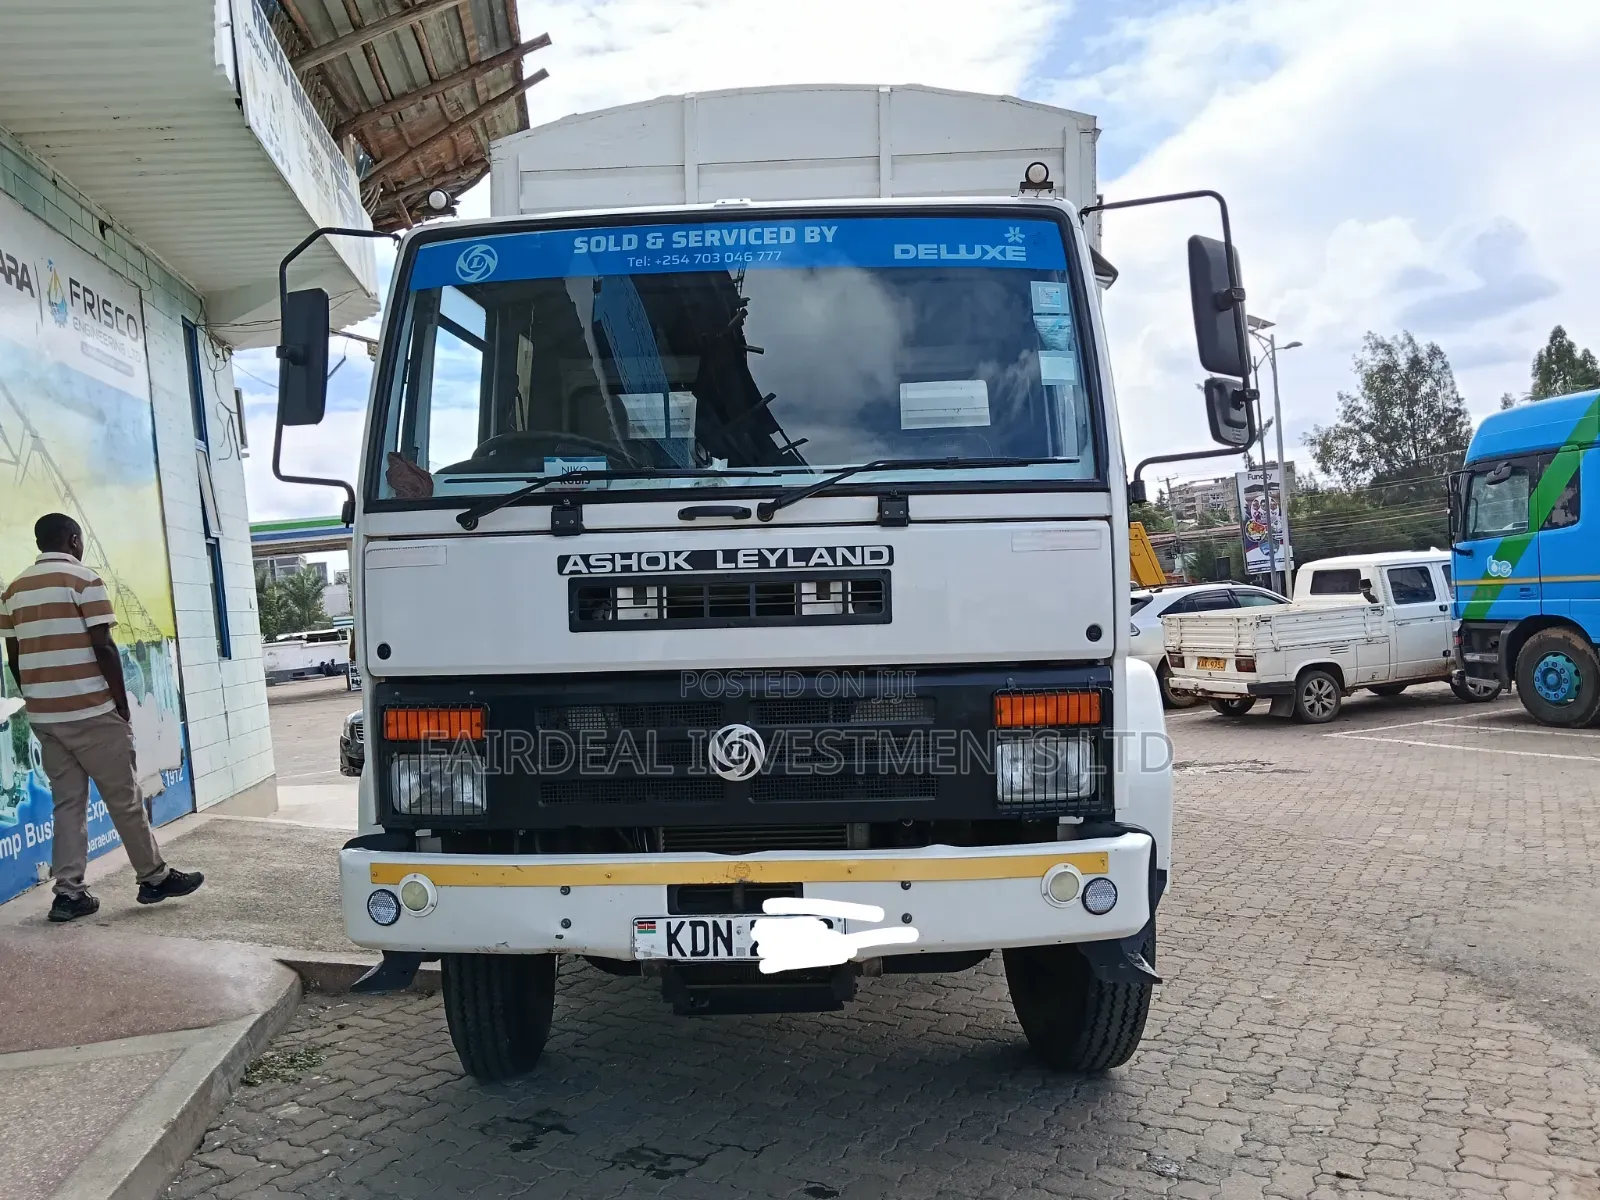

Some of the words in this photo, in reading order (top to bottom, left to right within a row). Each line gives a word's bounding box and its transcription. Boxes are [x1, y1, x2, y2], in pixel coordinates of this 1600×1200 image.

[251, 0, 289, 87] FRISCO
[573, 234, 638, 254] SOLD
[645, 232, 665, 250] &
[672, 226, 796, 249] SERVICED
[804, 225, 838, 244] BY
[894, 243, 1027, 262] DELUXE
[627, 256, 651, 268] Tel:
[654, 253, 690, 266] +254
[693, 252, 720, 265] 703
[724, 251, 753, 263] 046
[756, 250, 782, 262] 777
[68, 276, 139, 343] FRISCO
[72, 316, 126, 357] ENGINEERING
[128, 347, 141, 363] LTD
[562, 550, 694, 575] ASHOK
[716, 545, 890, 570] LEYLAND
[729, 743, 747, 760] L
[666, 919, 734, 958] KDN
